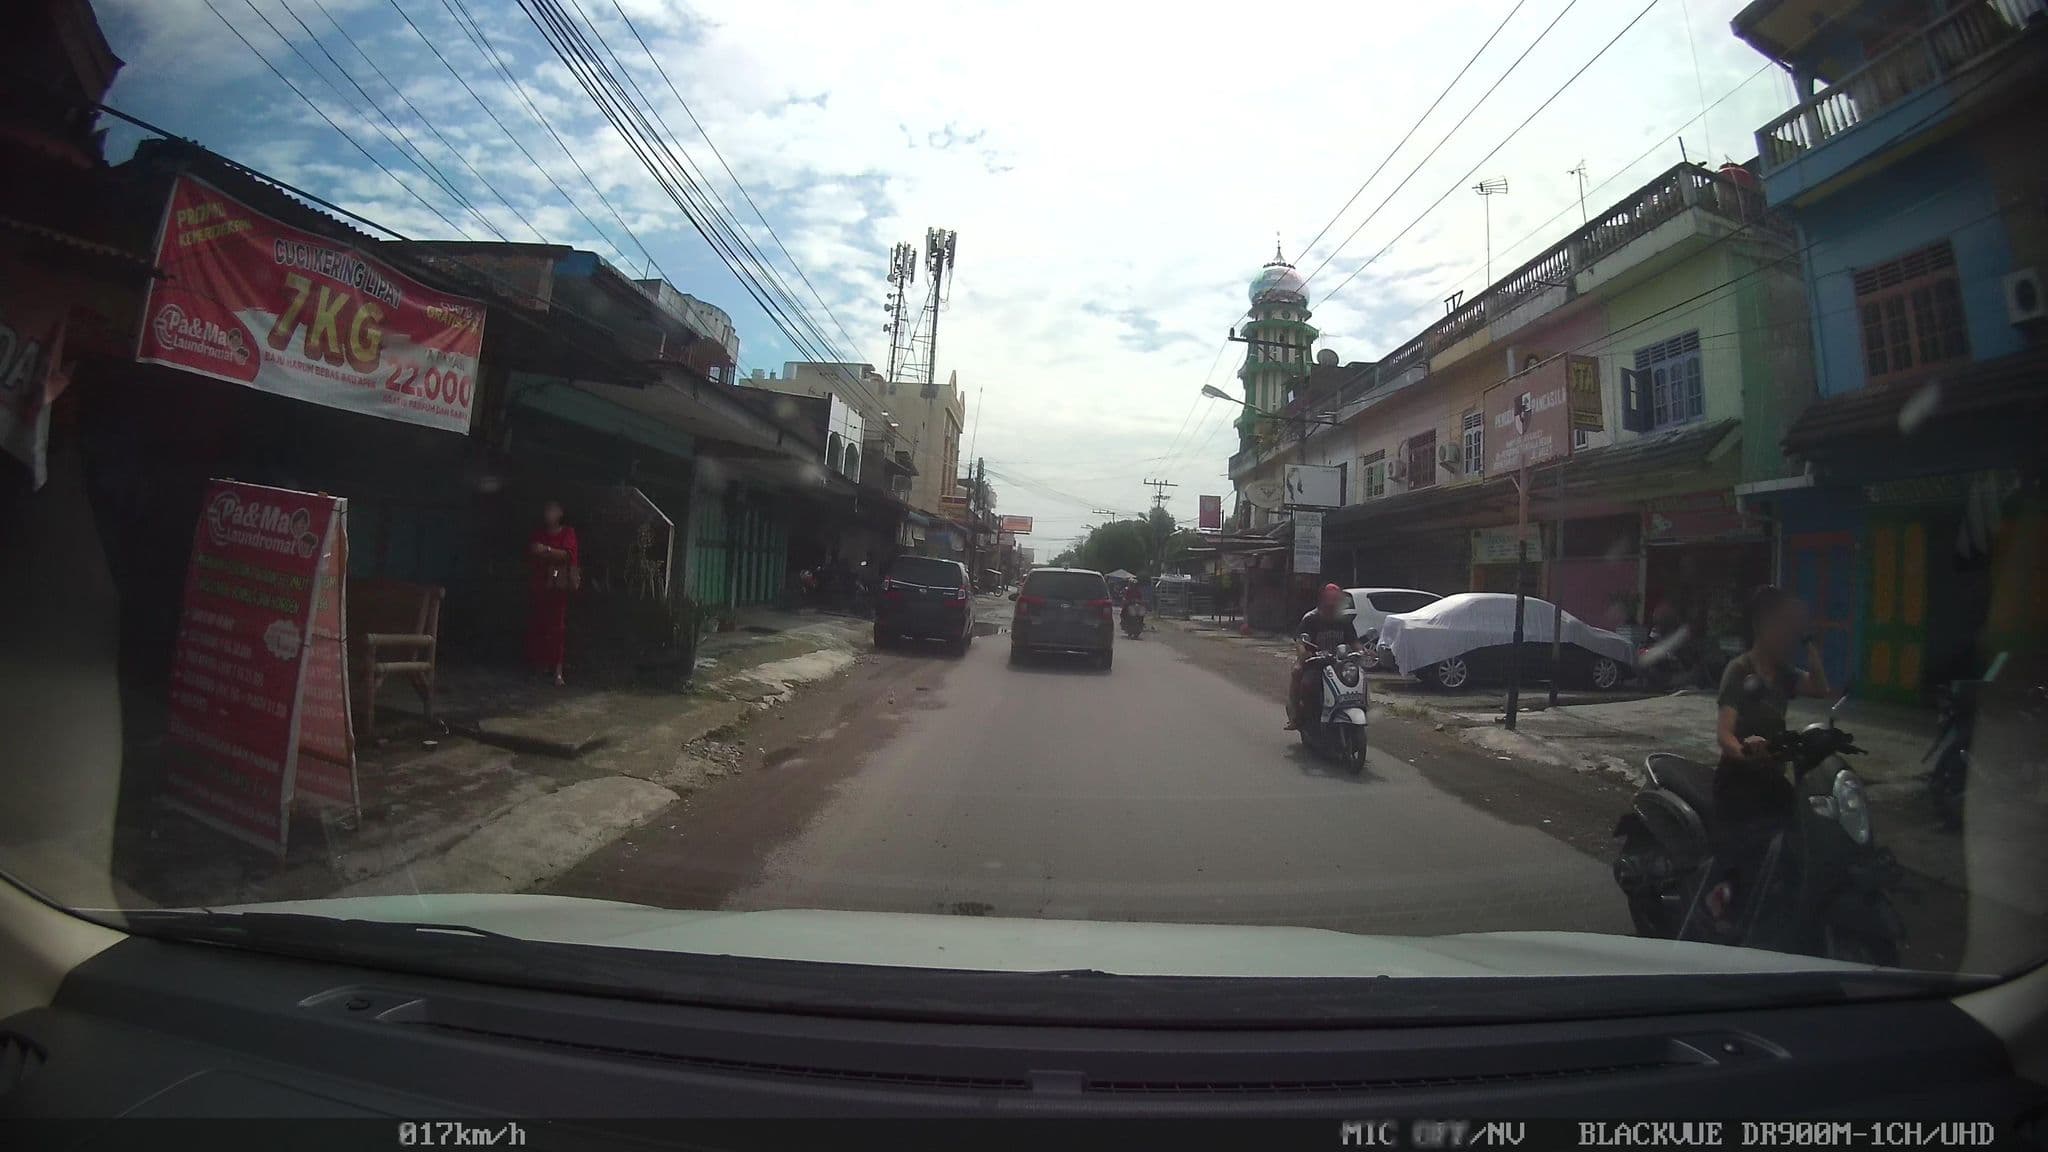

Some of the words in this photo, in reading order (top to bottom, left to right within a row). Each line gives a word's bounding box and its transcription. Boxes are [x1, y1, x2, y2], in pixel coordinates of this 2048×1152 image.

[273, 238, 310, 271] CUCI
[310, 246, 365, 289] KERING
[168, 310, 228, 347] Pa&Ma
[173, 334, 234, 362] Laundromat
[384, 367, 472, 409] 22.000
[222, 497, 291, 534] Pa&Ma
[226, 527, 298, 555] Laundromat
